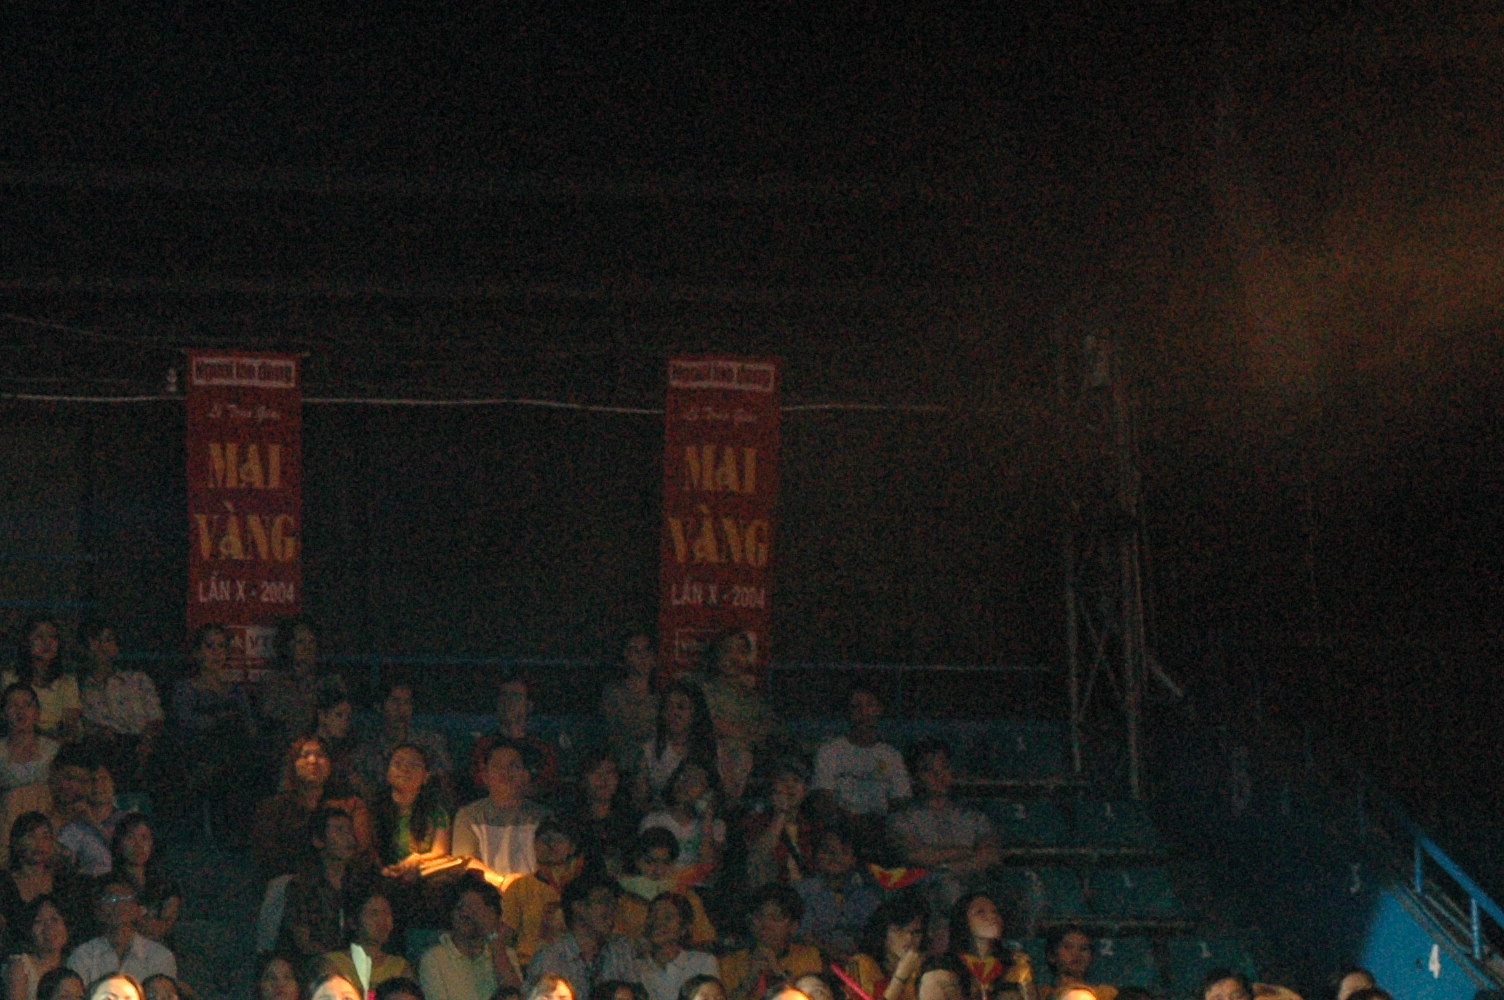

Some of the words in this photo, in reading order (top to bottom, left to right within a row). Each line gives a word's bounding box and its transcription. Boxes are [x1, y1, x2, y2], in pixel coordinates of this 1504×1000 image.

[208, 442, 283, 490] MAI
[684, 445, 758, 494] MAI
[195, 502, 297, 563] VÀNG
[668, 504, 769, 568] VÀNG
[235, 580, 246, 602] X
[260, 580, 295, 604] 2004
[707, 585, 718, 604] X
[733, 583, 766, 609] 2004
